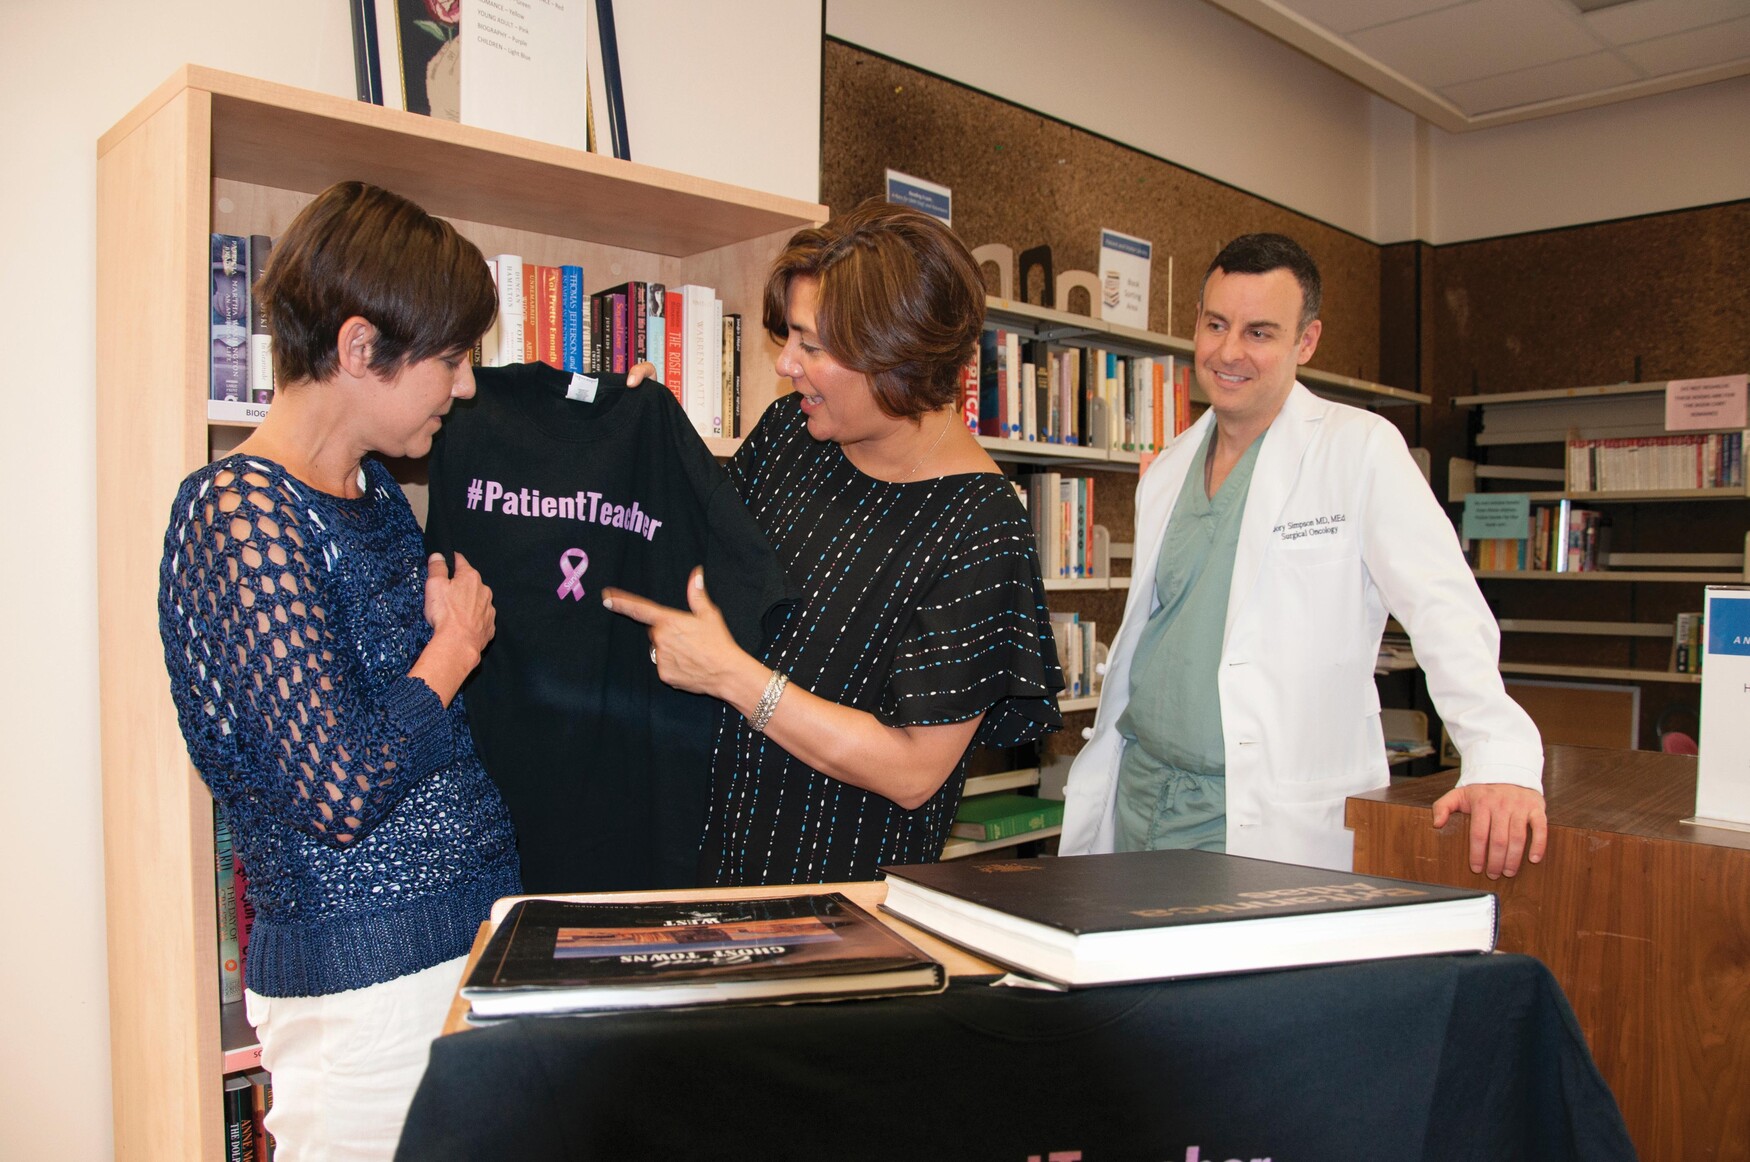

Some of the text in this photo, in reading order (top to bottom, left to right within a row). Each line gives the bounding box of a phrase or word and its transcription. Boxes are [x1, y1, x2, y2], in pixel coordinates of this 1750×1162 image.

[477, 9, 497, 22] YOUNG
[496, 17, 514, 28] ADULT
[477, 22, 507, 38] BIOGRAPHY
[477, 35, 503, 50] CHILDREN
[547, 275, 558, 363] Not Pretty Enough
[568, 272, 578, 370] THOMAS JEFFERSON and
[669, 332, 682, 348] THE
[669, 352, 682, 376] ROSIE
[696, 320, 704, 408] WARREN BEATTY
[466, 478, 663, 542] #PatientTeacher
[1287, 520, 1315, 530] Simpson
[1315, 516, 1330, 525] MD,
[1281, 525, 1339, 541] Surgical Oncology
[1237, 882, 1378, 899] Atlas
[1130, 887, 1430, 918] Britannica
[663, 917, 721, 927] WEST
[620, 946, 785, 963] GHOST TOWNS
[253, 1050, 262, 1058] SC
[230, 1123, 241, 1162] THE DOLP
[241, 1119, 252, 1149] ANNE
